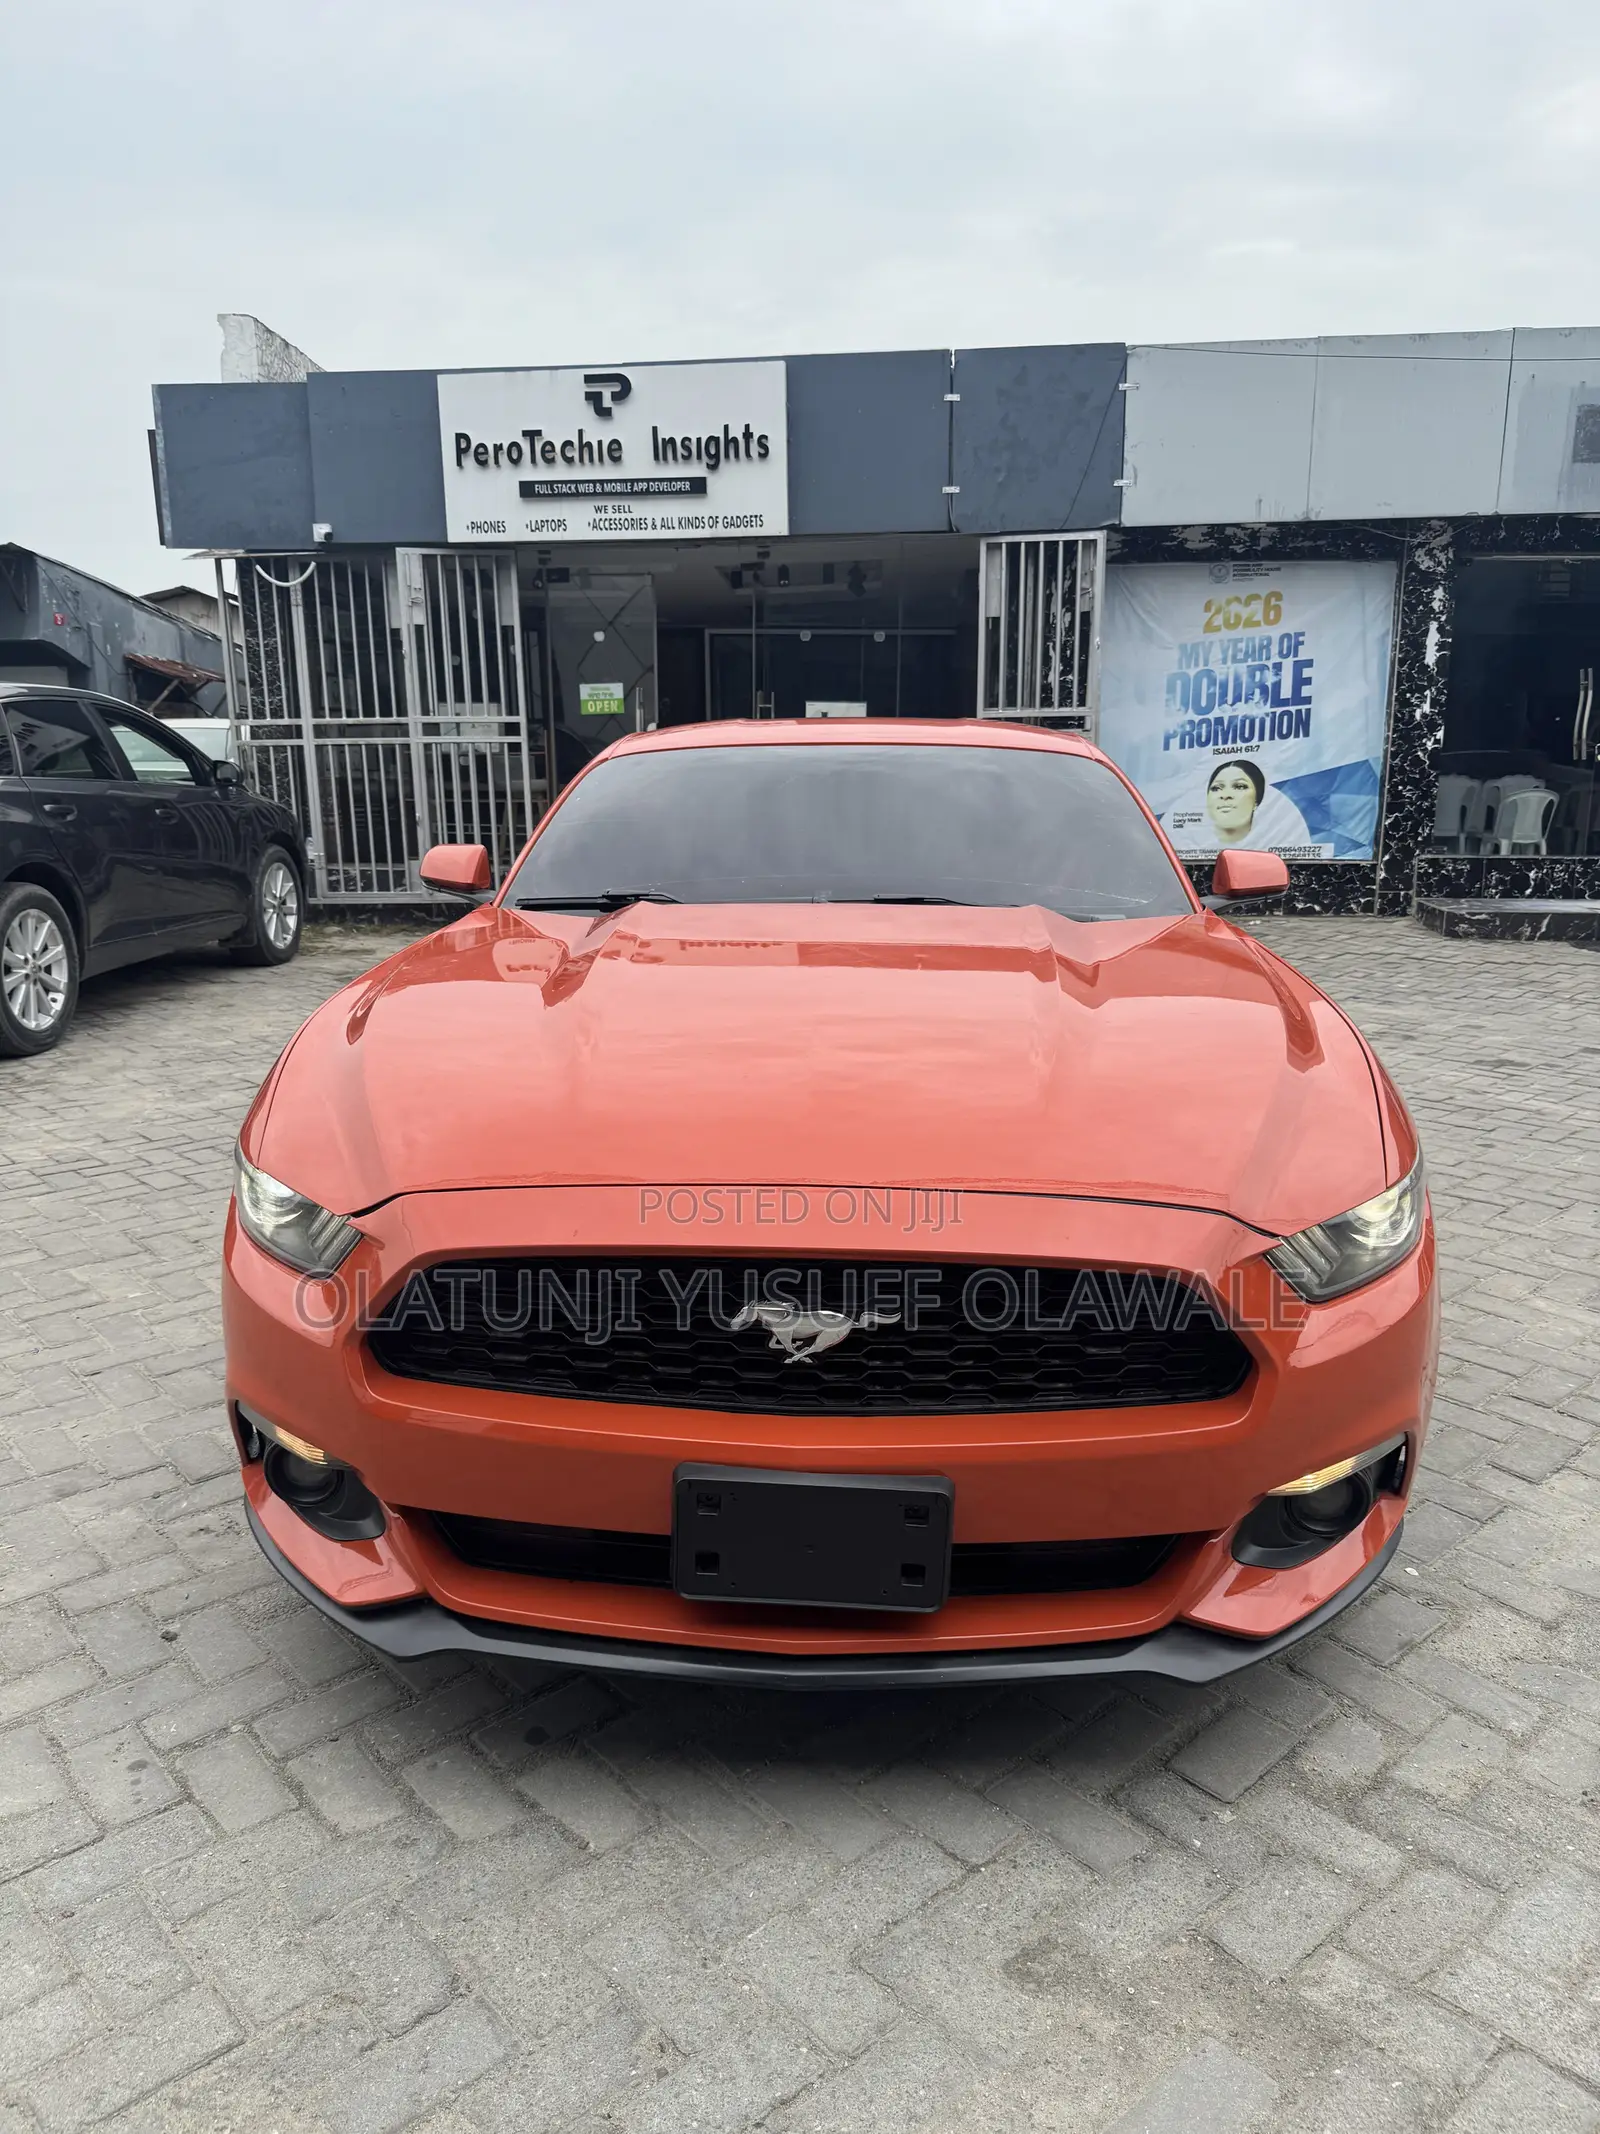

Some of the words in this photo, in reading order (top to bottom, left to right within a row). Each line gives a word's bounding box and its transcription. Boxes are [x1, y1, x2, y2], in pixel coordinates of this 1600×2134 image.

[454, 428, 623, 468] PeroTechie
[651, 423, 770, 470] Insights
[535, 483, 552, 494] FULL
[553, 483, 577, 494] STACK
[578, 482, 594, 493] WEB
[595, 482, 602, 493] &
[604, 482, 632, 493] MOBILE
[633, 481, 648, 492] APP
[650, 481, 691, 492] DEVELOPER
[593, 505, 609, 514] WE
[612, 504, 633, 514] SELL
[471, 520, 507, 534] PHONES
[529, 519, 568, 532] LAPTOPS
[592, 517, 648, 531] ACCESSORIES
[651, 518, 658, 530] &
[660, 517, 676, 530] ALL
[678, 516, 706, 530] KINDS
[707, 515, 720, 529] OF
[722, 514, 764, 529] GADGETS
[1203, 590, 1284, 634] 2026
[1177, 640, 1214, 670] MY
[1219, 635, 1273, 665] YEAR
[1277, 631, 1306, 660] OF
[1164, 658, 1314, 718] DOUBLE
[587, 700, 618, 713] OPEN
[1163, 707, 1312, 751] PROMOTION
[1212, 747, 1243, 756] ISAIAH
[1244, 745, 1260, 754] 61:7
